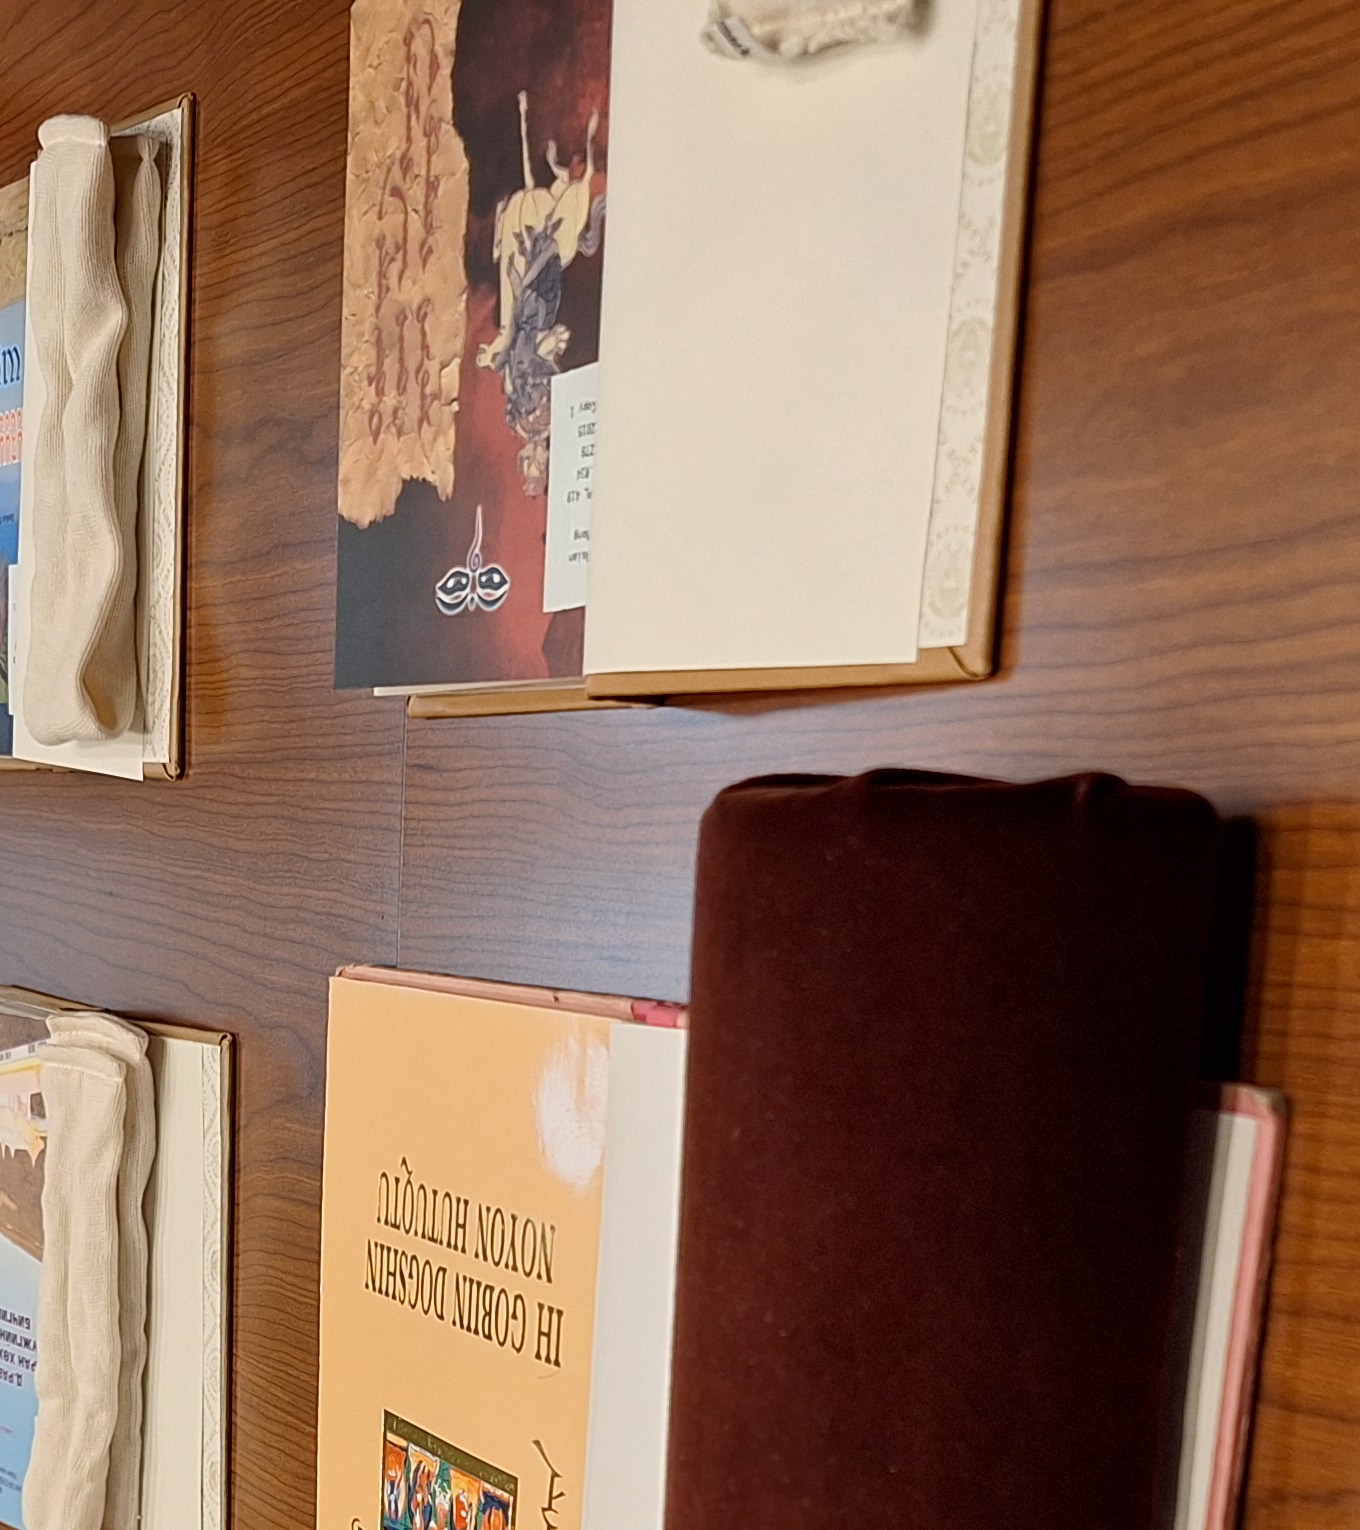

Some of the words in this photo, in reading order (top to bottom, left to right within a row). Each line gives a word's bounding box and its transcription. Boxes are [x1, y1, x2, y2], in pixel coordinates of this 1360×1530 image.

[376, 1156, 470, 1255] HUTUQTU
[474, 1203, 556, 1285] NOYON
[364, 1238, 448, 1323] DOGSHIN
[451, 1271, 527, 1355] GOBIIN
[534, 1301, 565, 1369] IH
